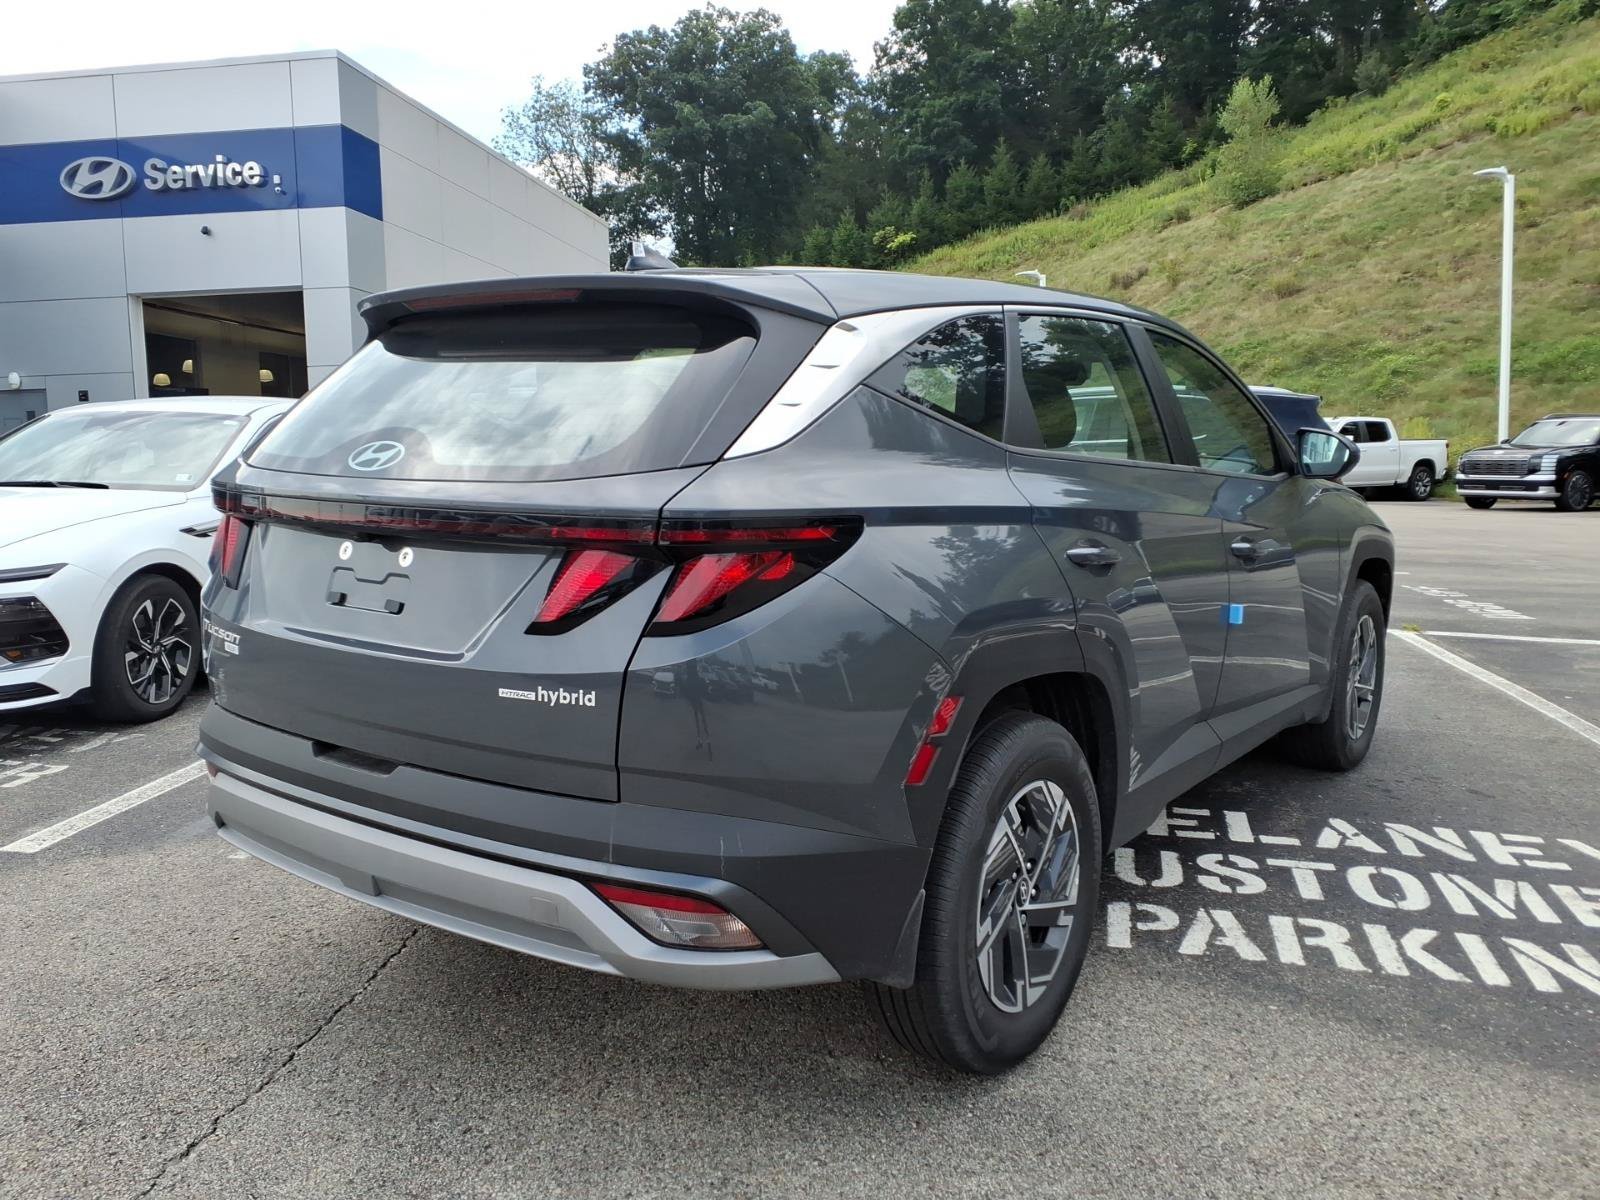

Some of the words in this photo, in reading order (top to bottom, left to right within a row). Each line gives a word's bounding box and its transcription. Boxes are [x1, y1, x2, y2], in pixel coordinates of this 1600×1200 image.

[143, 154, 264, 191] Service
[537, 686, 596, 706] hybrid
[1146, 806, 1600, 871] ELANE
[1106, 901, 1600, 997] PARKIN
